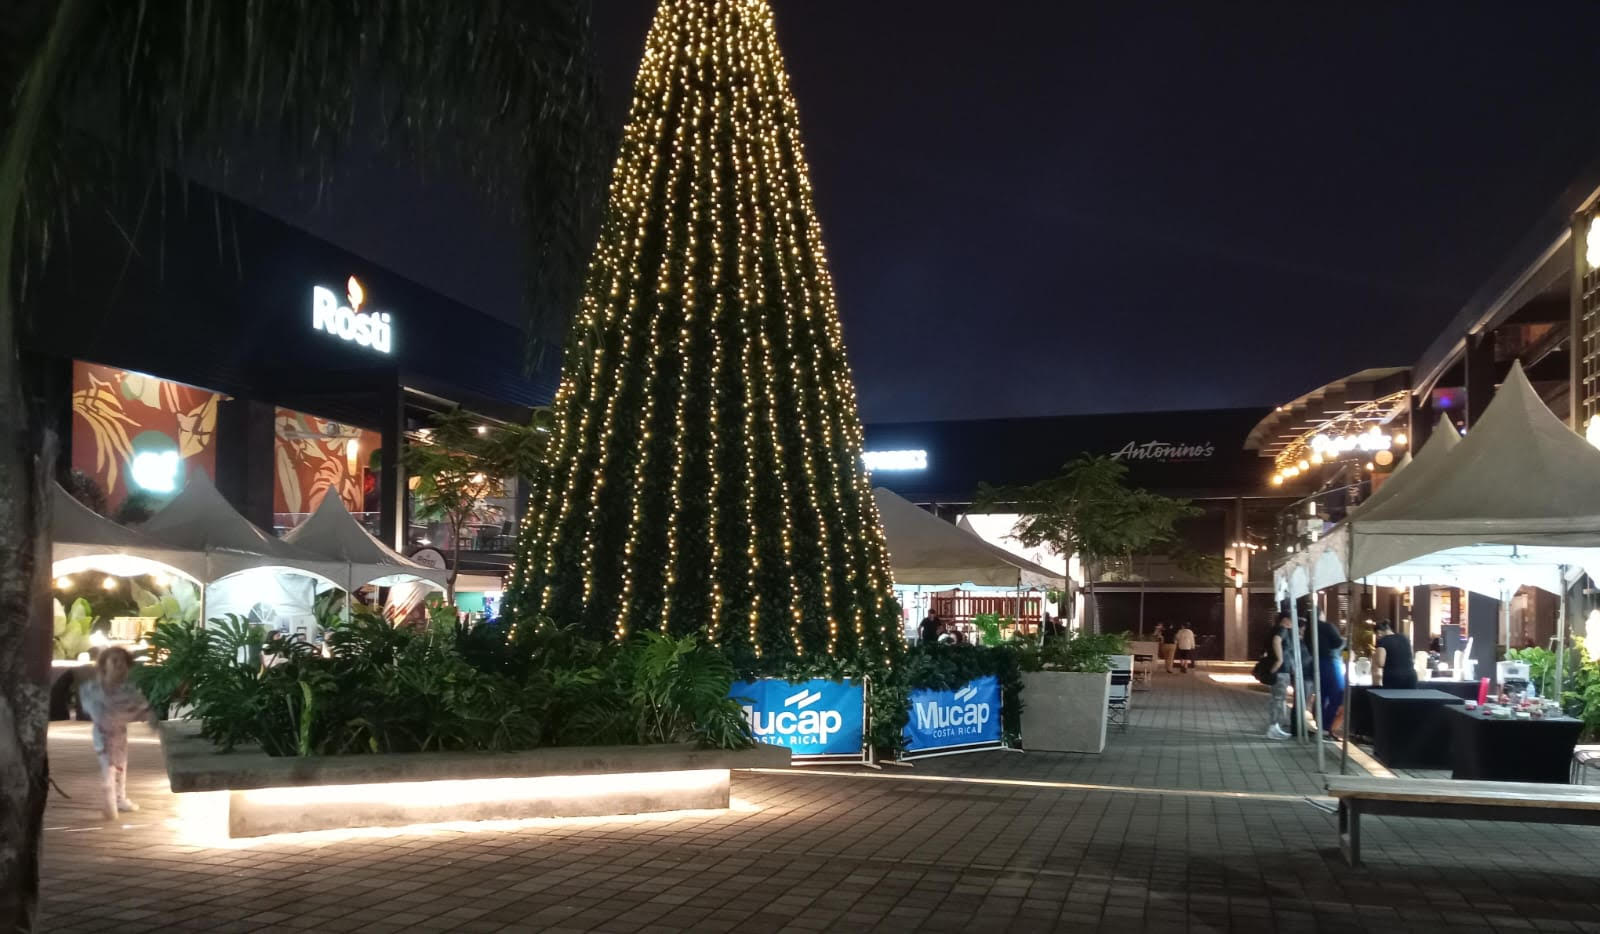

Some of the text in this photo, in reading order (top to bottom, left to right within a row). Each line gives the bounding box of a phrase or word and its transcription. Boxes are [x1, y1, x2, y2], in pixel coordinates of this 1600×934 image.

[313, 285, 391, 353] Rosti
[1110, 440, 1215, 460] Antonino's
[916, 702, 990, 733] Mucap
[790, 735, 818, 745] RICA
[933, 726, 976, 738] COSTA RICA
